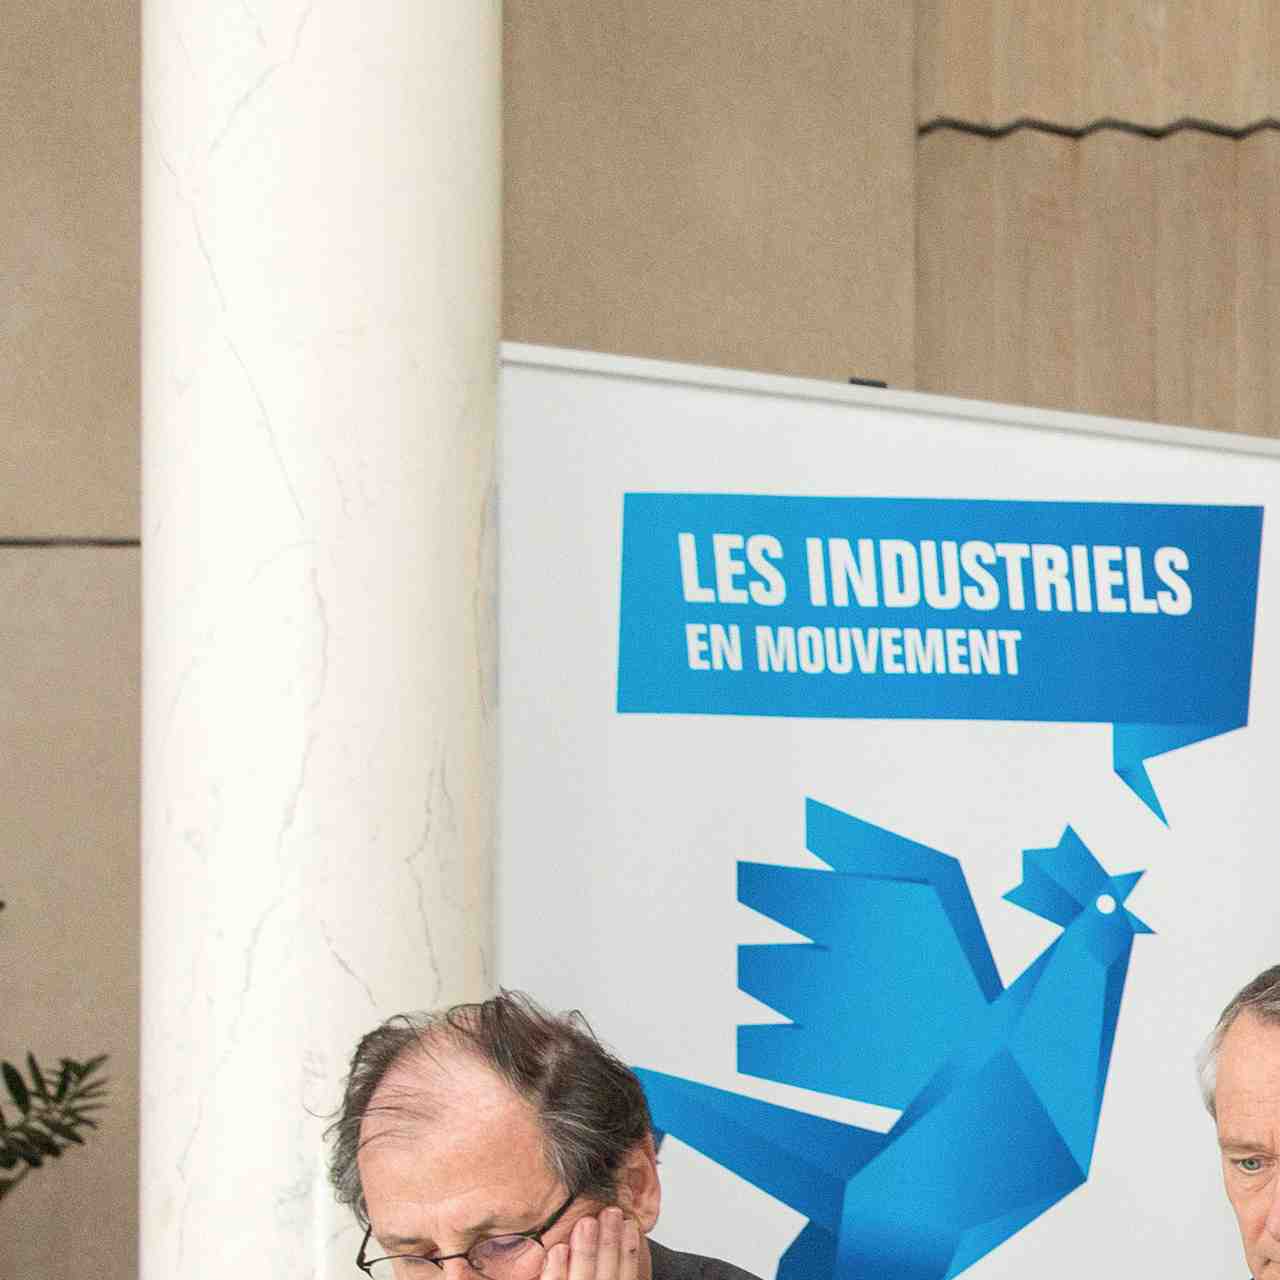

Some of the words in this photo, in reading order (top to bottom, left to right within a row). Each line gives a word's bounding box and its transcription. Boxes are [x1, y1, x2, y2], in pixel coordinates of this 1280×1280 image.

[678, 533, 786, 606] LES
[806, 537, 1193, 615] INDUSTRIELS
[686, 623, 742, 671] EN
[755, 626, 1022, 676] MOUVEMENT
